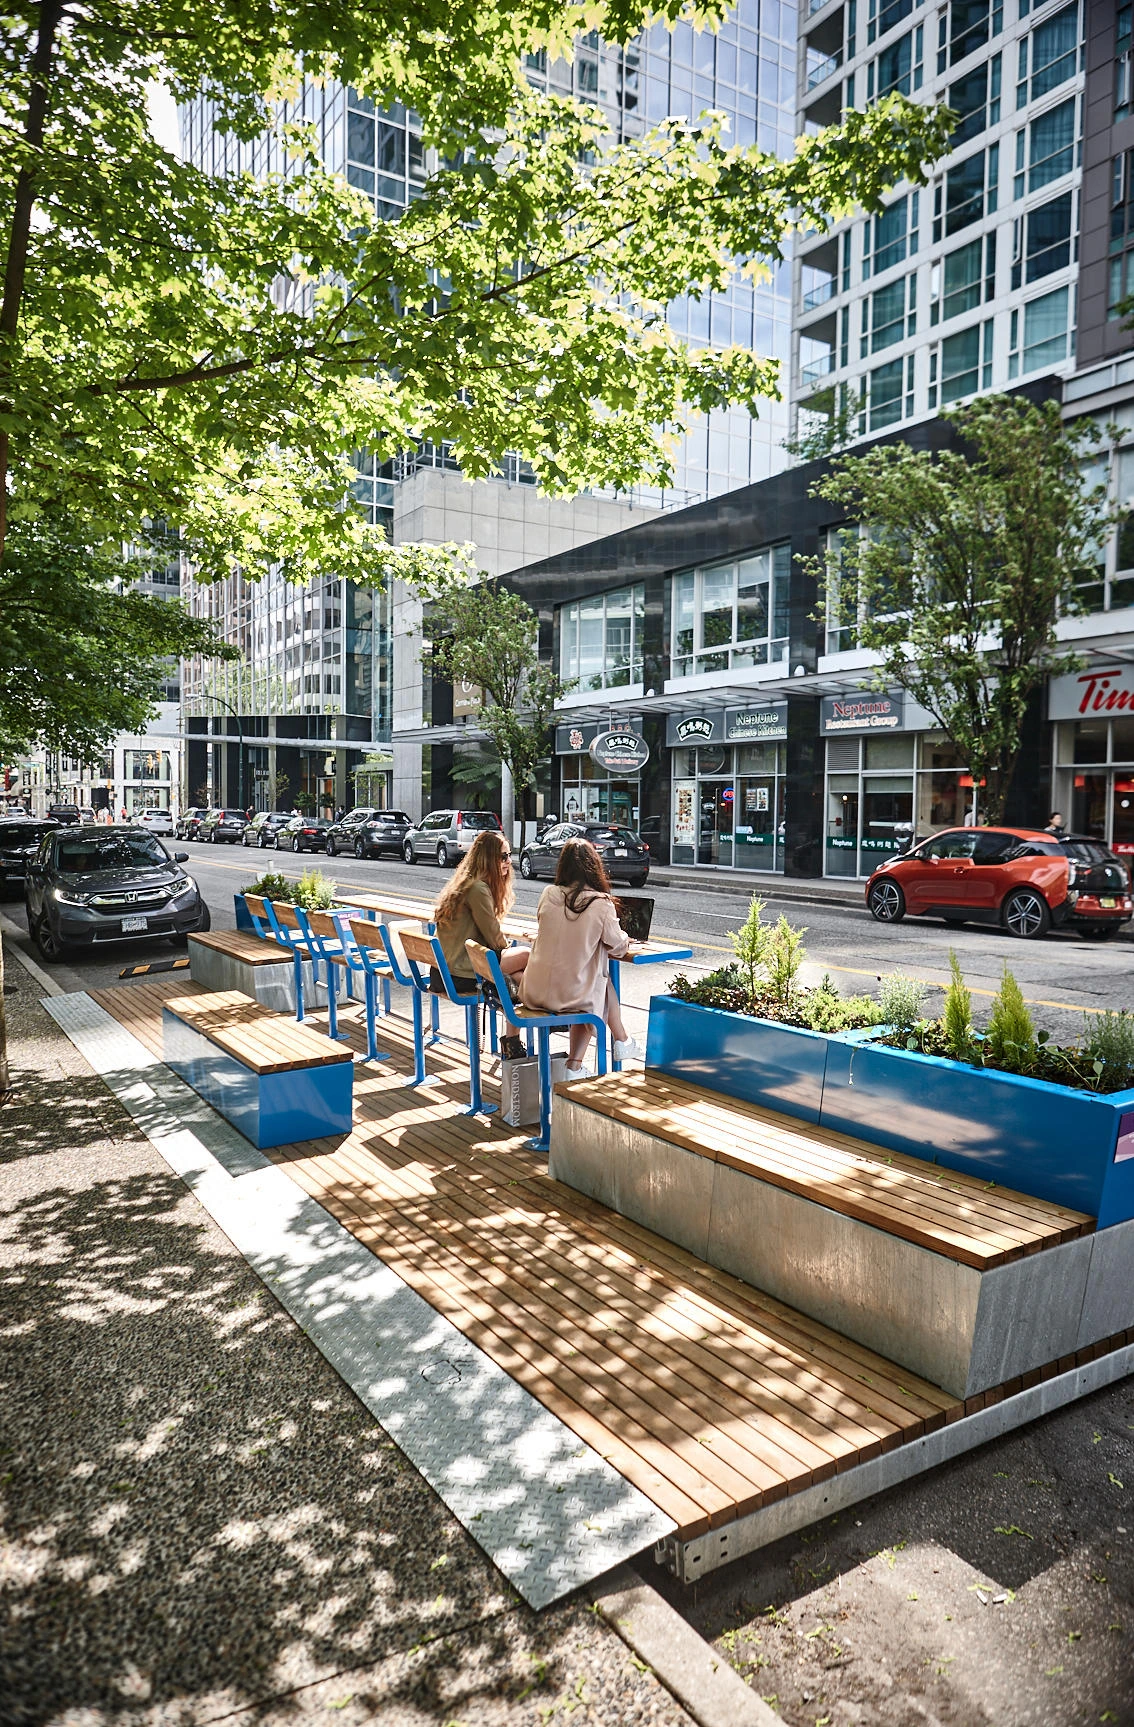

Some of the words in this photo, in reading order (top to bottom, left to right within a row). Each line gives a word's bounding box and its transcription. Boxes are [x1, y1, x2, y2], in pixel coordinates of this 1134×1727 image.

[1077, 670, 1134, 715] Tim
[832, 701, 891, 720] Neptune
[736, 712, 779, 727] Neptune
[825, 717, 870, 729] Restaurant
[870, 715, 899, 728] Group
[728, 726, 757, 739] Chinese
[757, 725, 787, 737] Kitchen
[832, 839, 853, 848] Neptune
[511, 1065, 521, 1127] NORDSTROM
